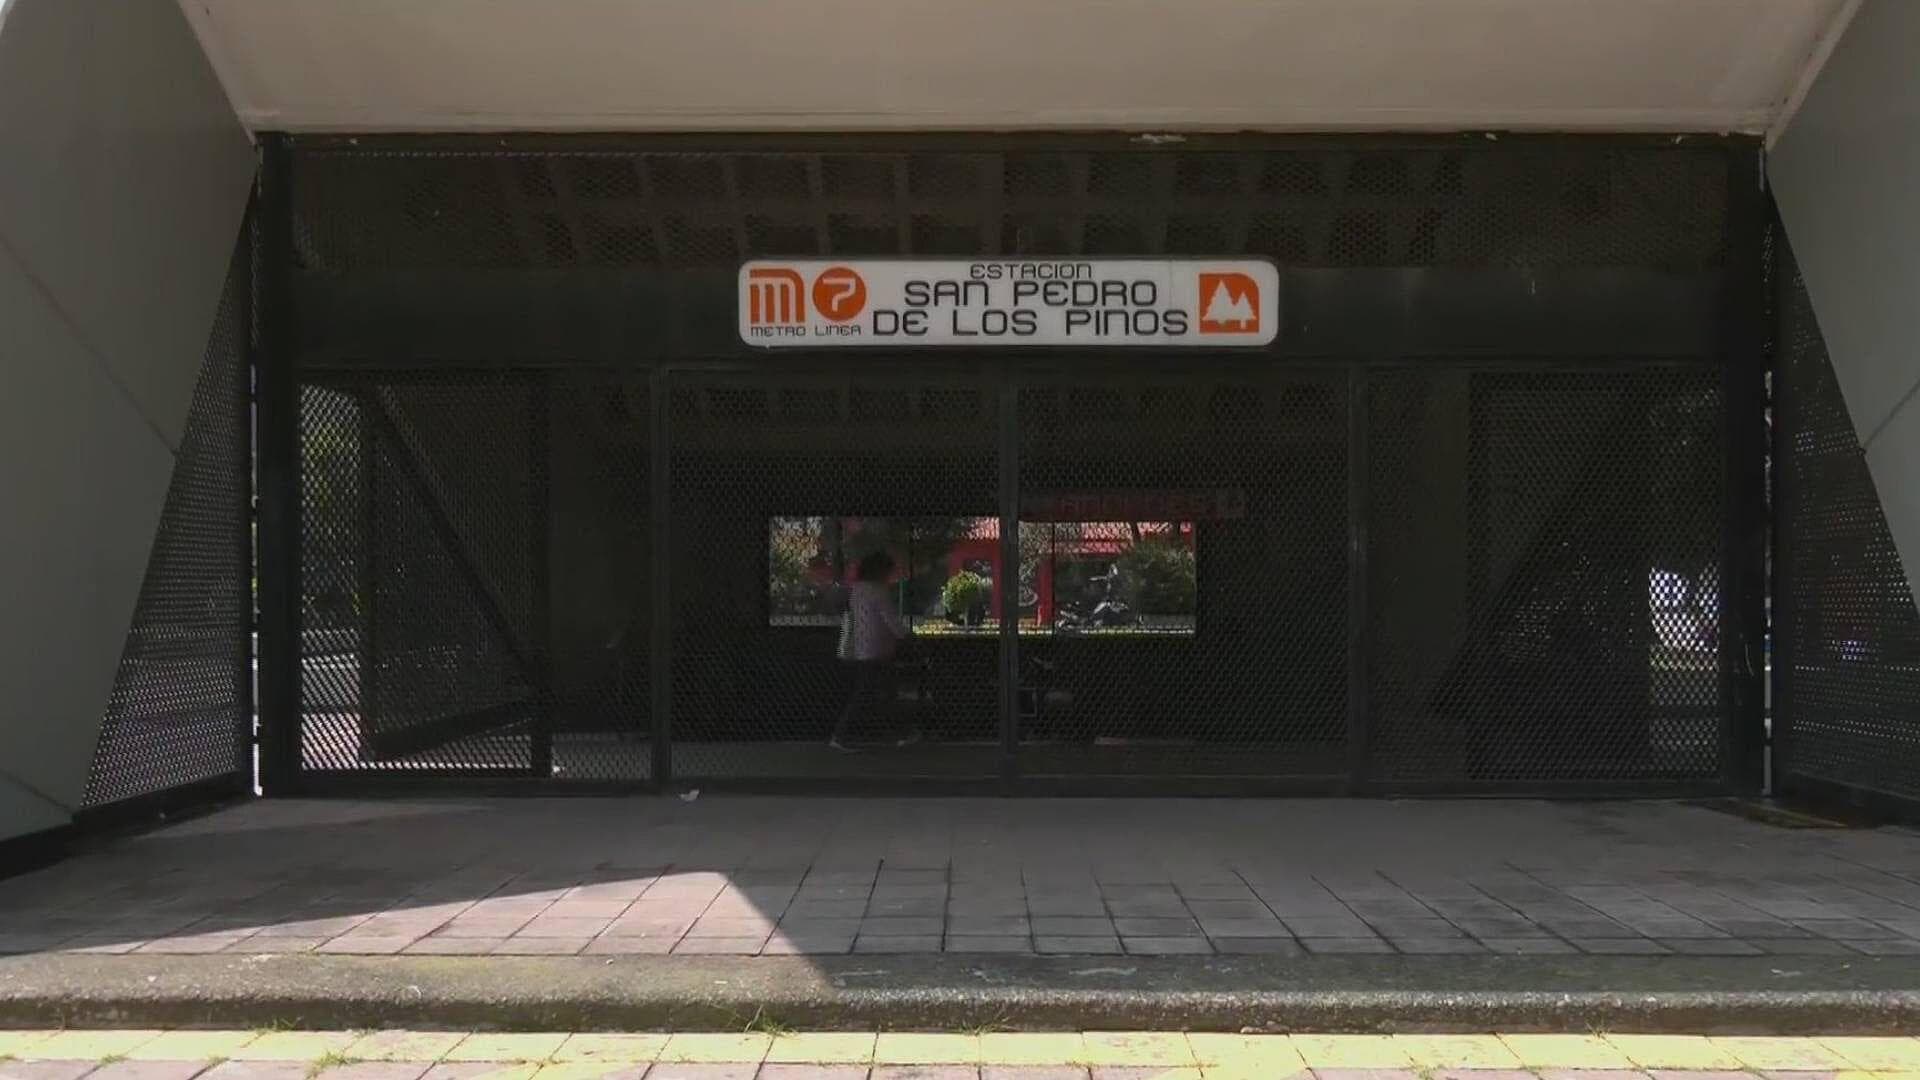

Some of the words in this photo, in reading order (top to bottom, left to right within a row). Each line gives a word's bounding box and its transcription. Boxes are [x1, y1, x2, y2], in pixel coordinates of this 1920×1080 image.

[969, 264, 1092, 279] ESTACION
[823, 278, 856, 312] 7
[905, 280, 989, 306] SAN
[1013, 280, 1157, 306] PEDRO
[750, 325, 806, 336] METRO
[815, 325, 861, 336] LINEA
[873, 309, 928, 336] DE
[952, 309, 1037, 336] LOS
[1066, 309, 1188, 336] PINOS
